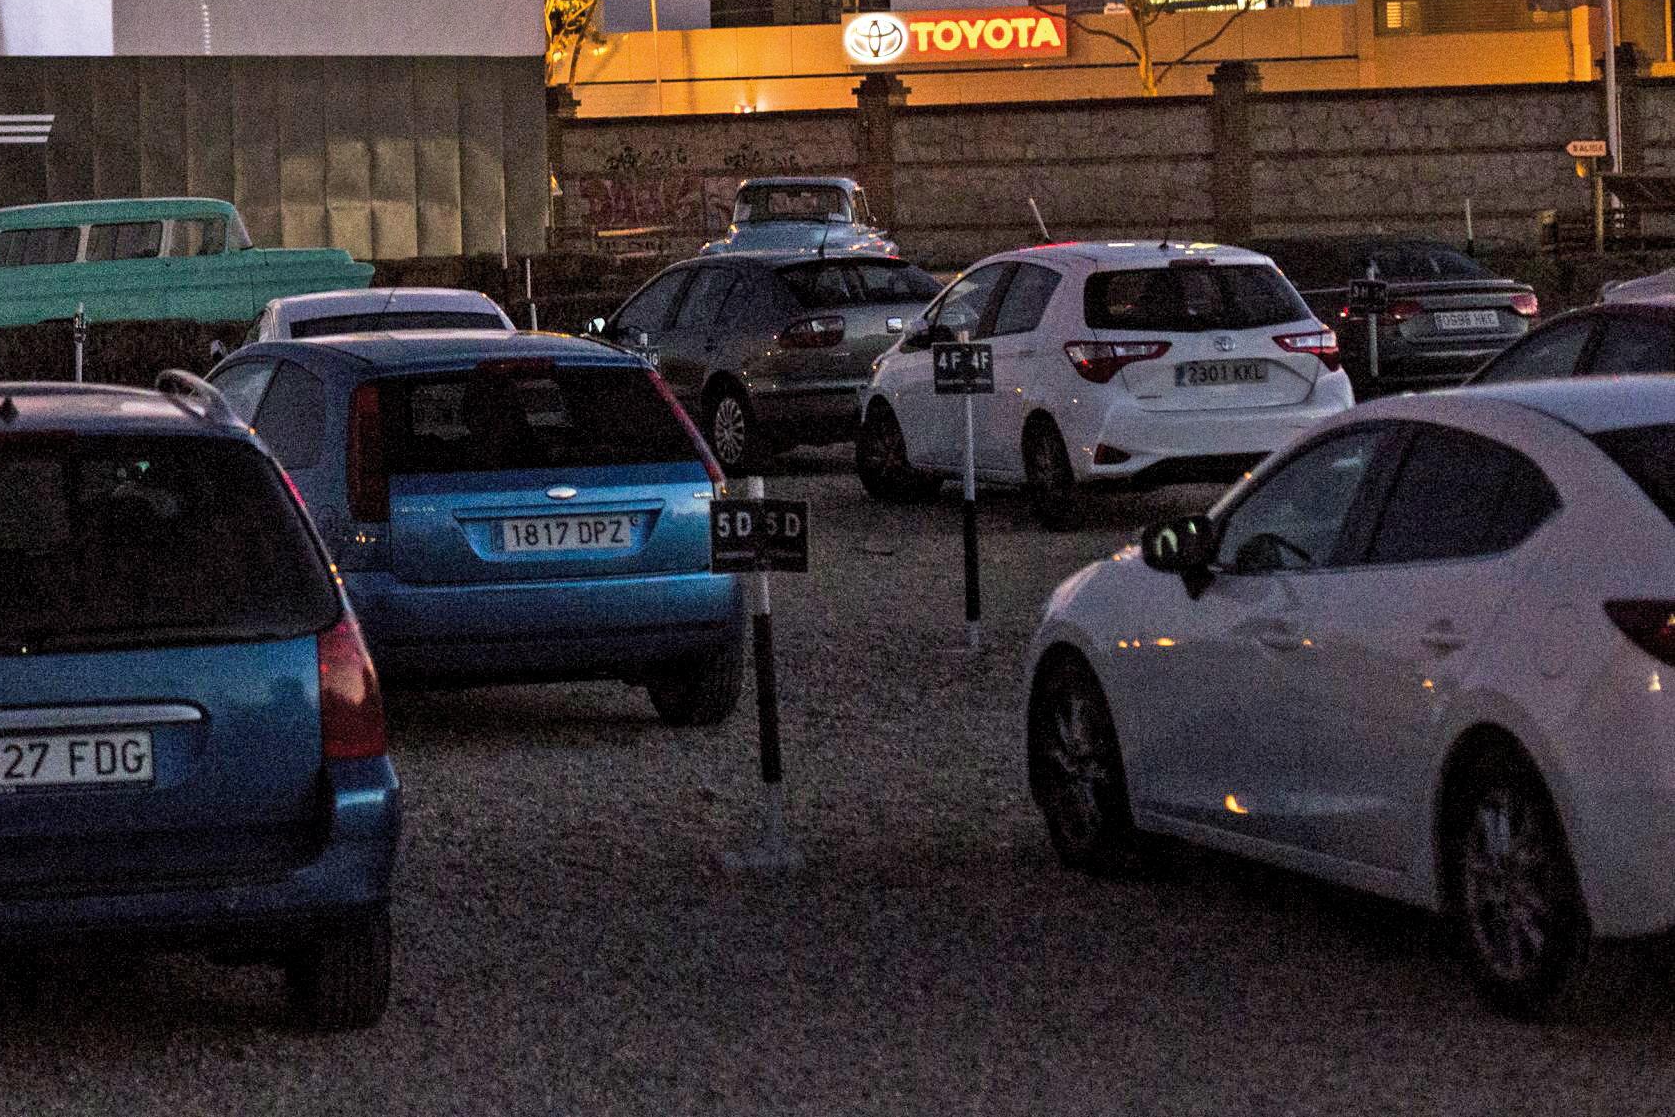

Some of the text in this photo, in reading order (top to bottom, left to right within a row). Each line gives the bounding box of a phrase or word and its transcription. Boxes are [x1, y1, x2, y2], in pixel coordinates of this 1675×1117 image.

[910, 17, 1061, 52] TOYOTA
[511, 519, 624, 548] 1817 DPZ
[68, 739, 146, 777] FDG
